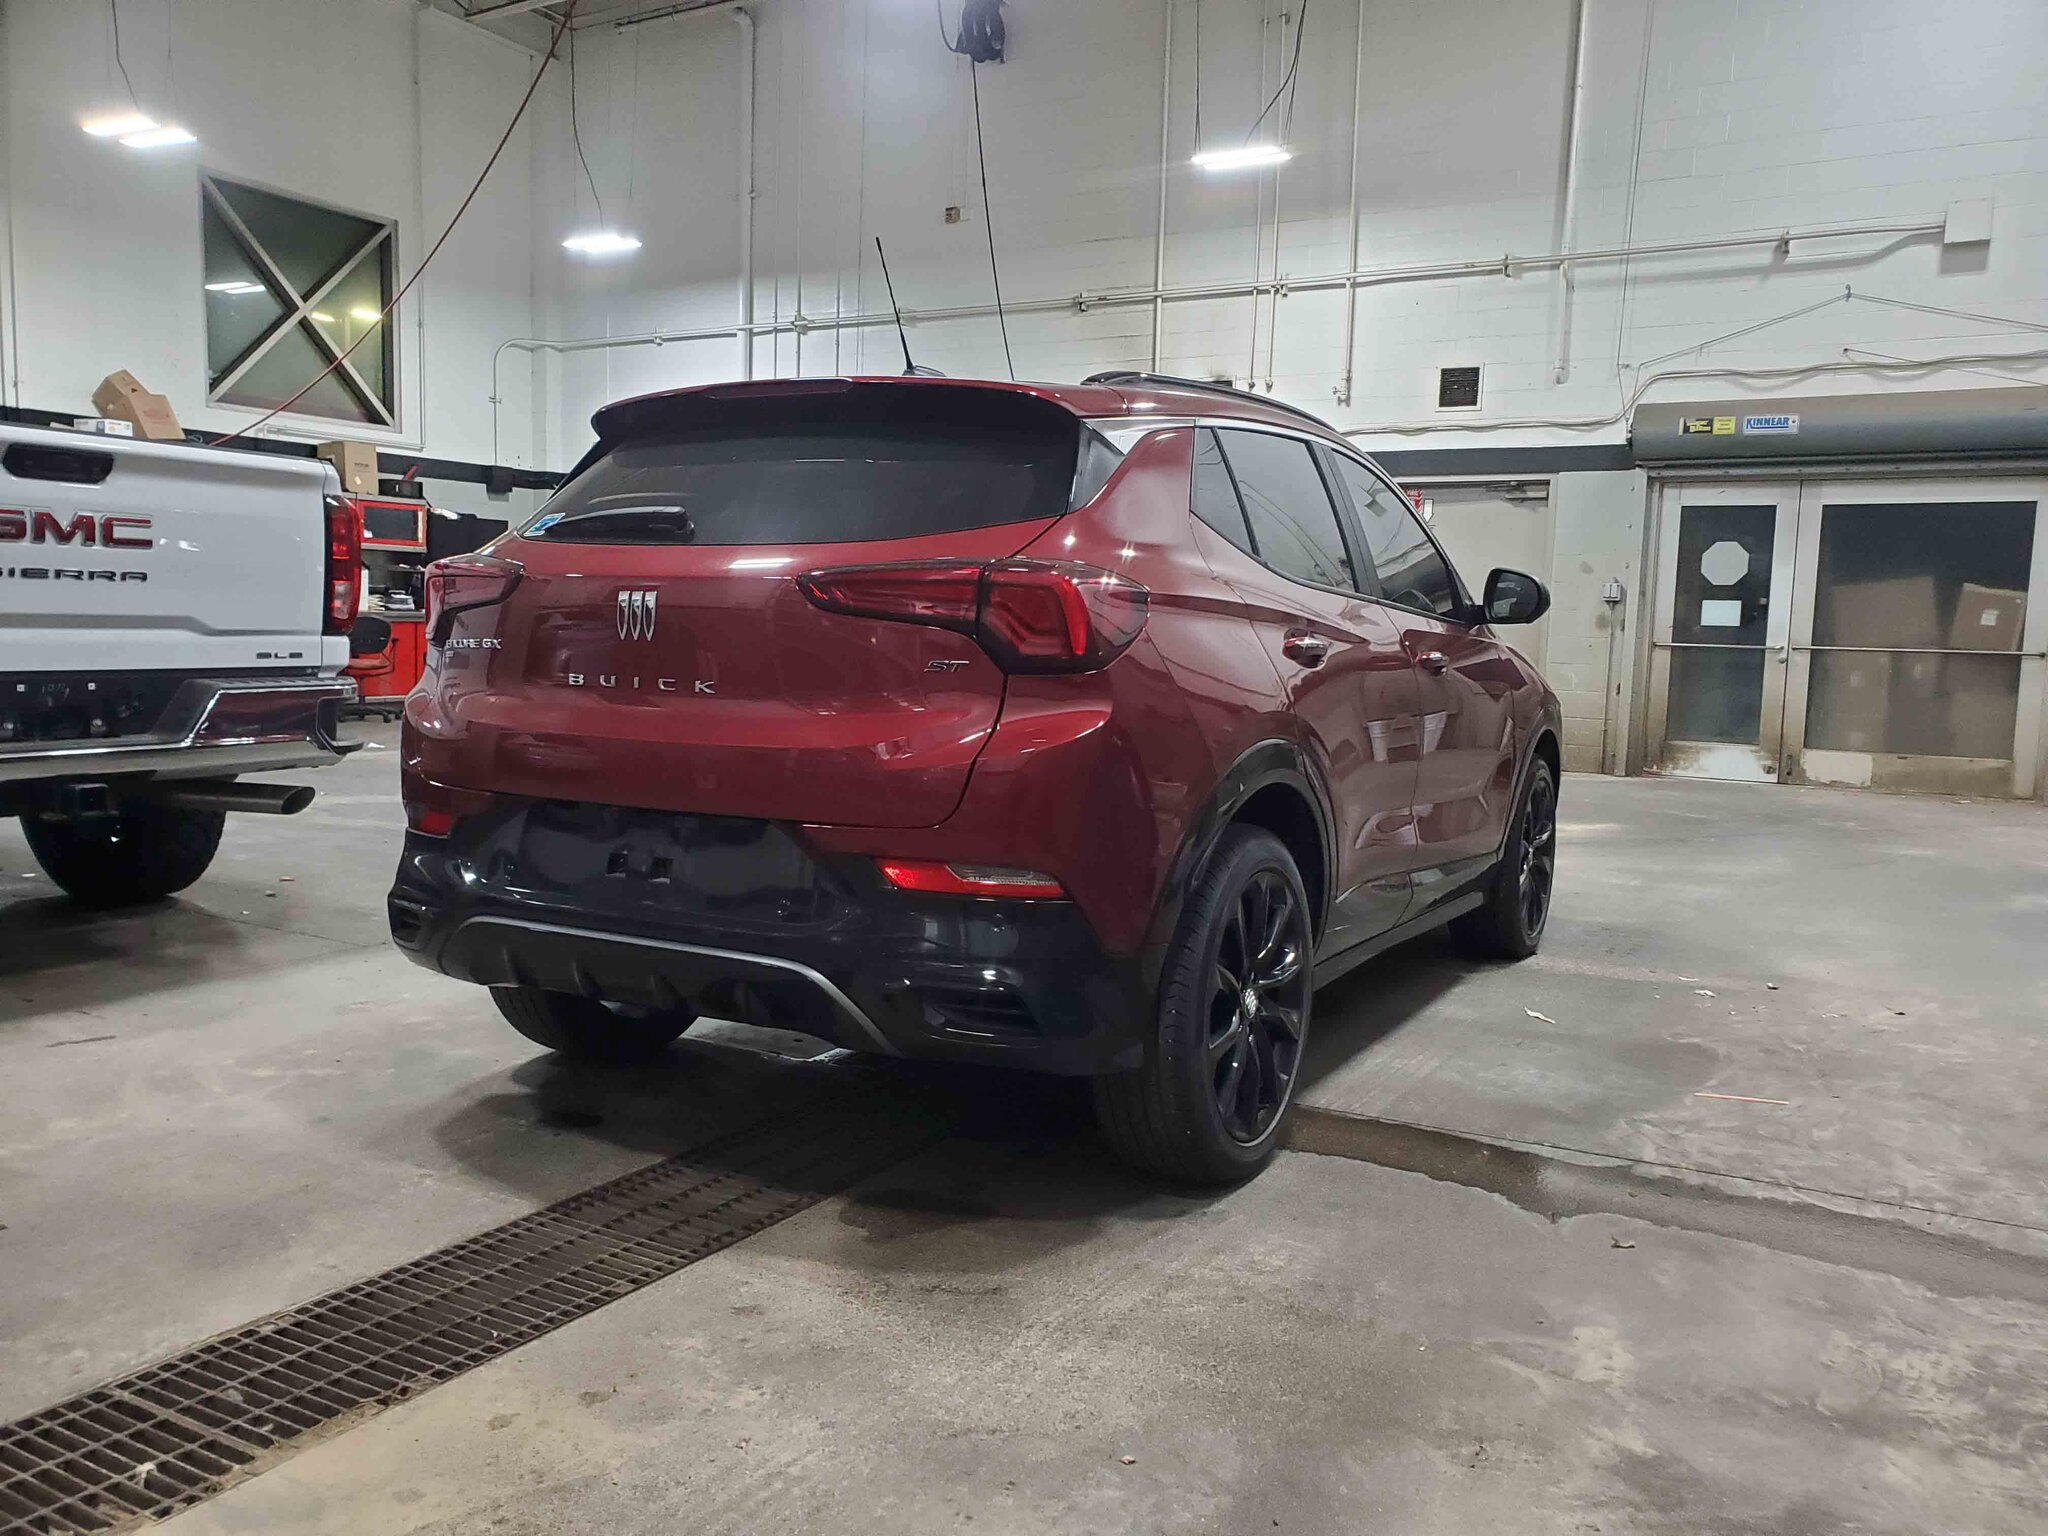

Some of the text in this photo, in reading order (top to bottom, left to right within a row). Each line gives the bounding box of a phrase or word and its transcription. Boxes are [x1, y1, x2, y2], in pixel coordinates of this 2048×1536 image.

[1745, 416, 1790, 429] KINNEAR
[0, 567, 148, 582] IERRA
[482, 638, 502, 650] GX
[923, 660, 970, 673] ST
[568, 673, 716, 694] BUICK
